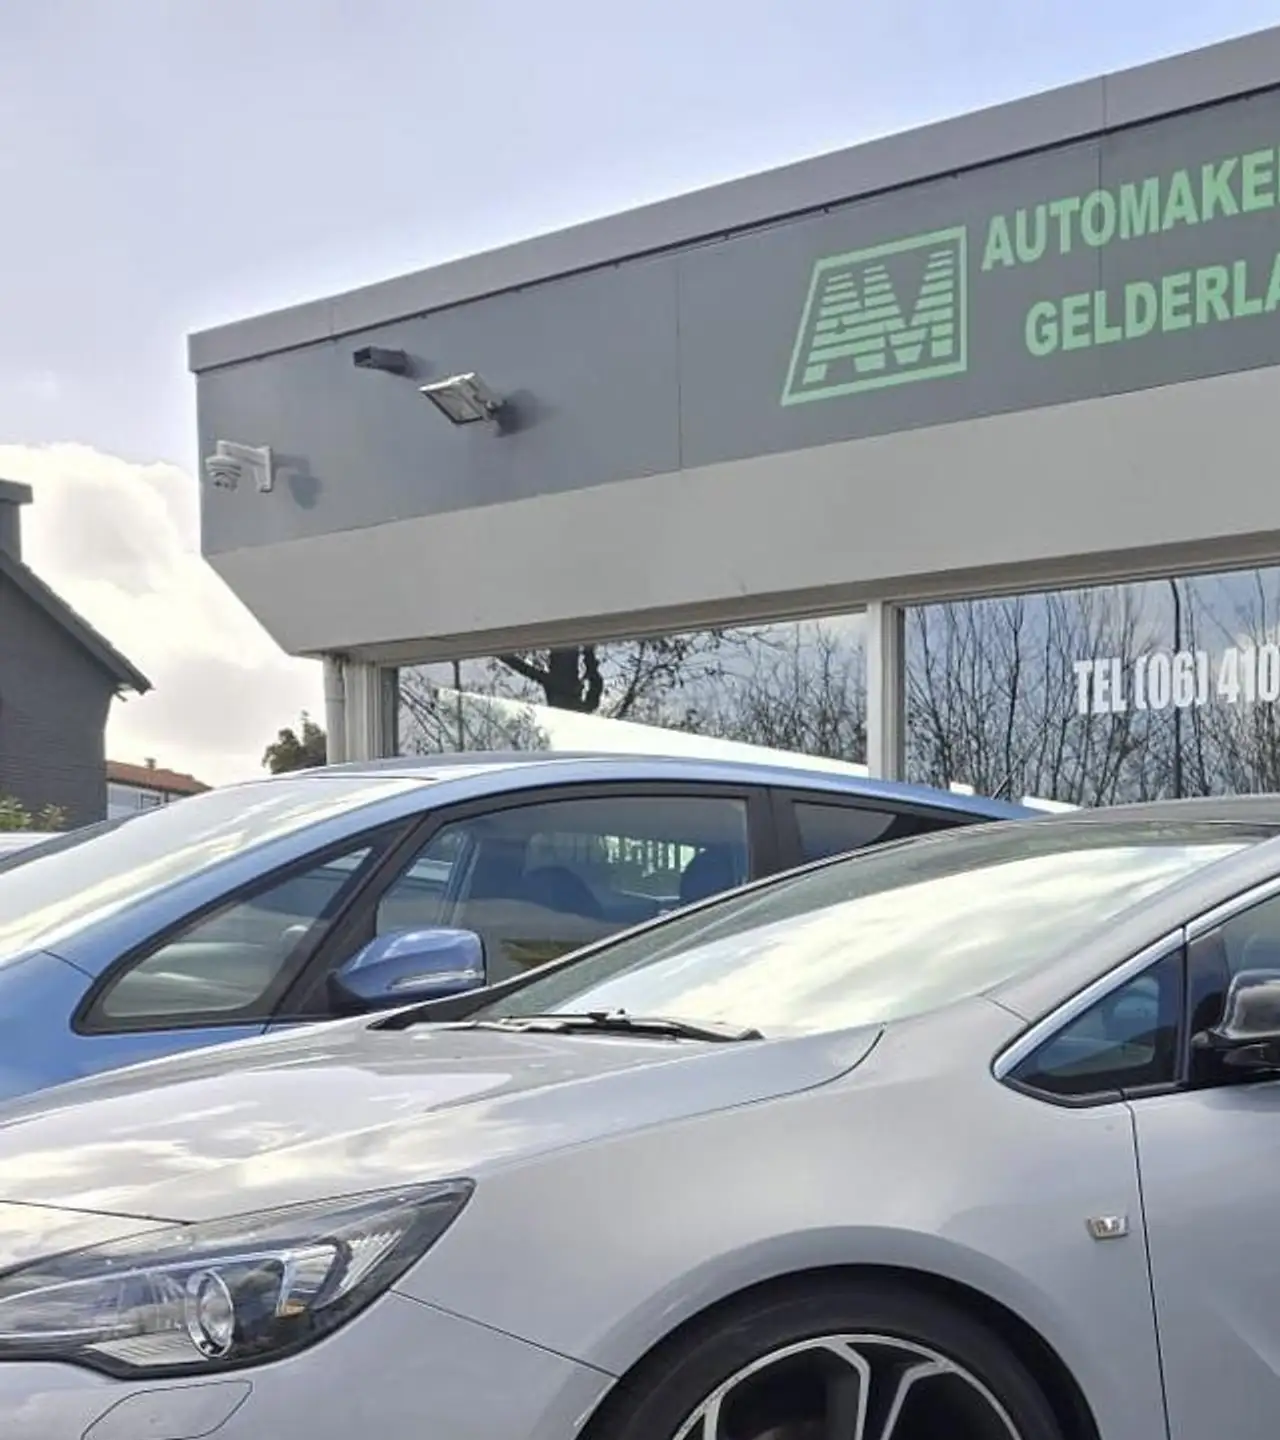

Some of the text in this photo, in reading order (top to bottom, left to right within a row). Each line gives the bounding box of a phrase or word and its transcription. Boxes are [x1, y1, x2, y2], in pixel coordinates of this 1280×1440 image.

[799, 247, 955, 387] AM
[1073, 658, 1127, 714] TEL
[1135, 651, 1208, 709] (06)
